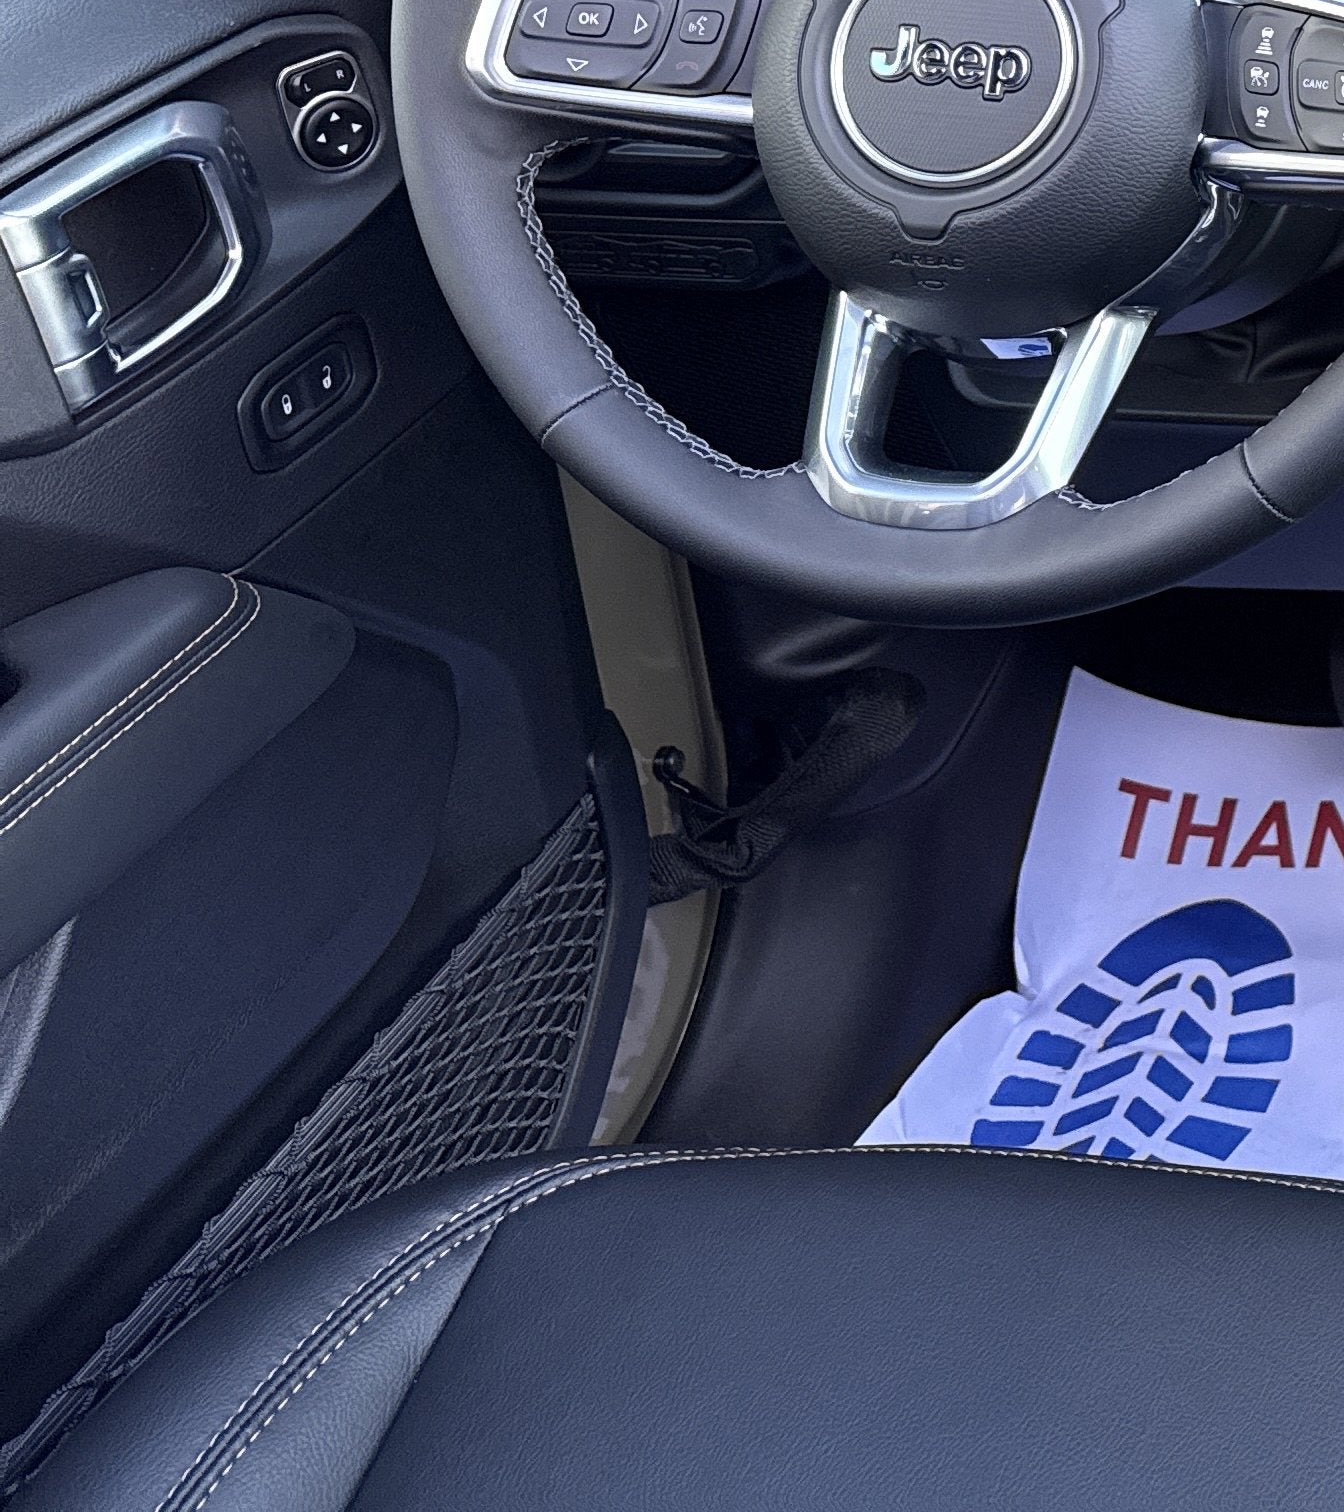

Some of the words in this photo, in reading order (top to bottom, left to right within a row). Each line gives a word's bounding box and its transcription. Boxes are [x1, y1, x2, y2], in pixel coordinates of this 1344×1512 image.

[578, 12, 600, 26] OK
[869, 24, 1031, 100] Jeep
[336, 69, 345, 80] R
[304, 82, 311, 92] L
[1303, 79, 1329, 90] CANC
